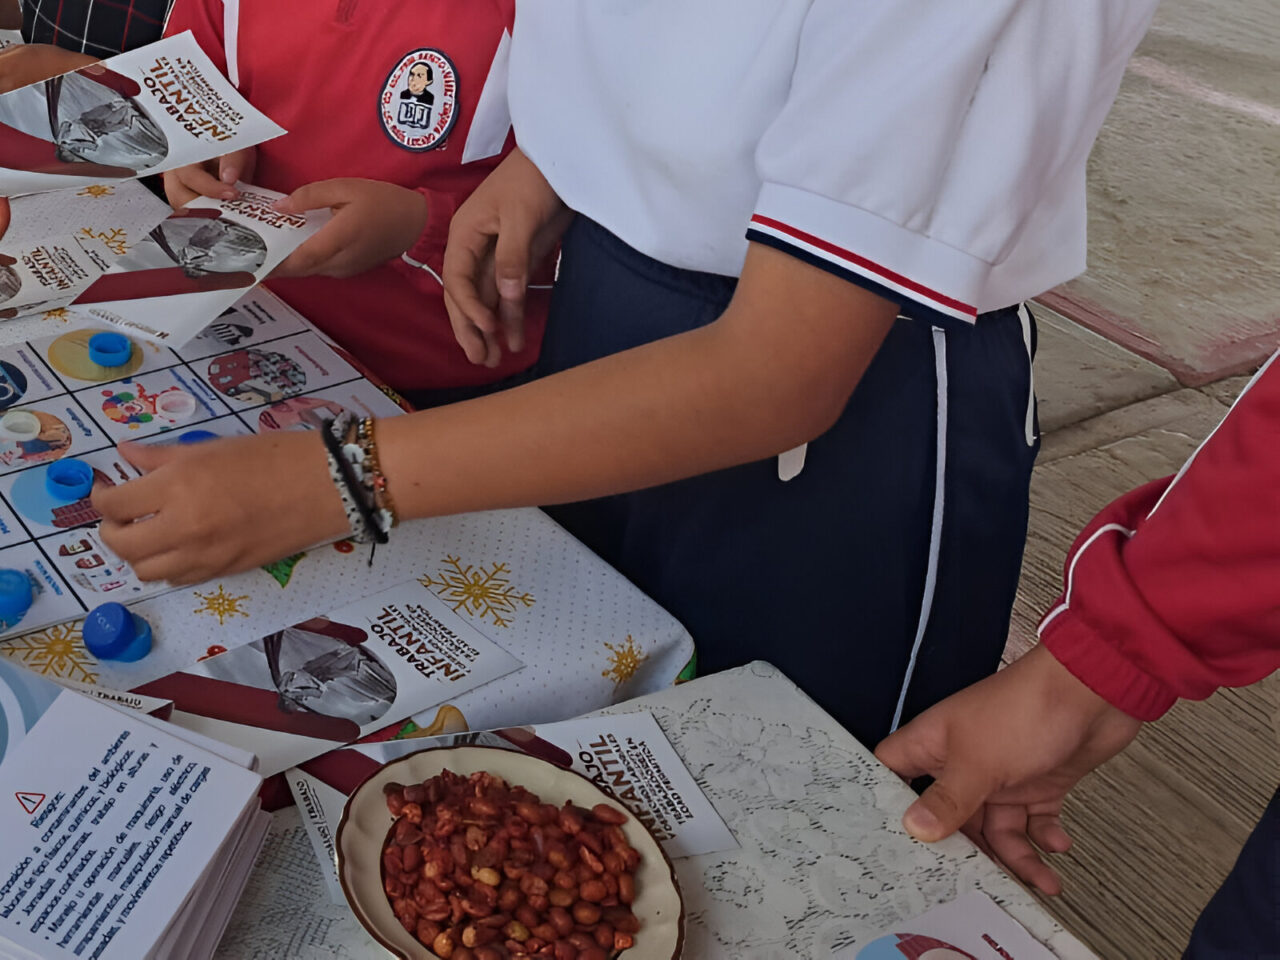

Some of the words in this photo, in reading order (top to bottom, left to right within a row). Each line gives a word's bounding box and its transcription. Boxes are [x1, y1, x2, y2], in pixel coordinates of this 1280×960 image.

[139, 74, 204, 140] TRABAJO
[148, 58, 232, 141] INFANTIL
[369, 621, 435, 679] TRABAJO
[375, 606, 466, 681] INFANTIL
[32, 845, 41, 854] a
[40, 781, 89, 845] contaminantes
[86, 766, 102, 783] del
[99, 727, 130, 766] ambiente
[118, 833, 164, 893] manipulación
[157, 803, 184, 836] manual
[179, 790, 193, 805] de
[188, 764, 213, 795] cargas
[588, 733, 668, 842] INFANTIL
[21, 874, 36, 889] de
[30, 856, 51, 878] tipo
[22, 874, 56, 917] Jornadas
[90, 794, 117, 827] trabajo
[115, 780, 128, 793] en
[125, 749, 150, 779] alturas
[47, 897, 79, 935] Manejo
[81, 844, 118, 890] operación
[113, 829, 128, 845] de
[159, 765, 175, 783] uso
[170, 751, 184, 766] de
[28, 892, 63, 935] espacios
[56, 888, 104, 950] herramientas
[143, 802, 167, 831] riesgo
[120, 860, 164, 918] movimientos
